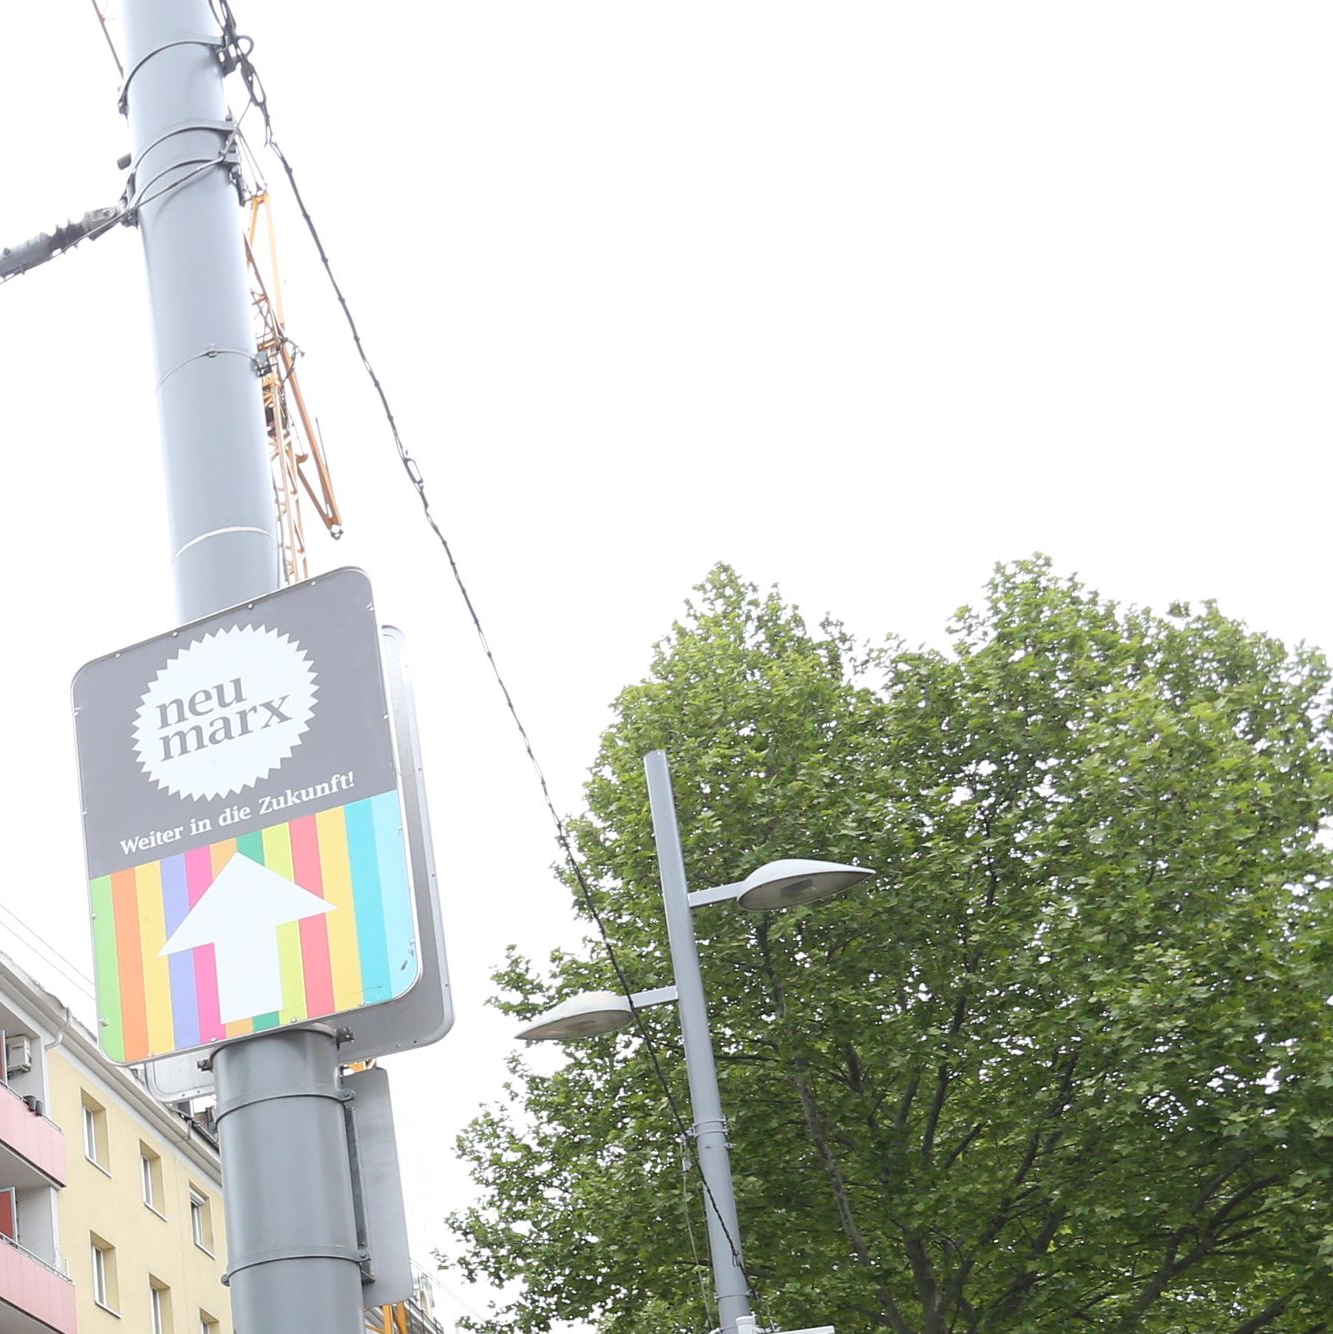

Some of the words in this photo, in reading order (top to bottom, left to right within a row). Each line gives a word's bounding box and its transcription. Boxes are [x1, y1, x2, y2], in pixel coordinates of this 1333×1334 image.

[155, 677, 247, 730] neu
[158, 694, 293, 762] marx
[120, 825, 183, 855] Weiter
[190, 818, 212, 836] in
[218, 805, 252, 827] die
[258, 771, 356, 815] Zukunft!
